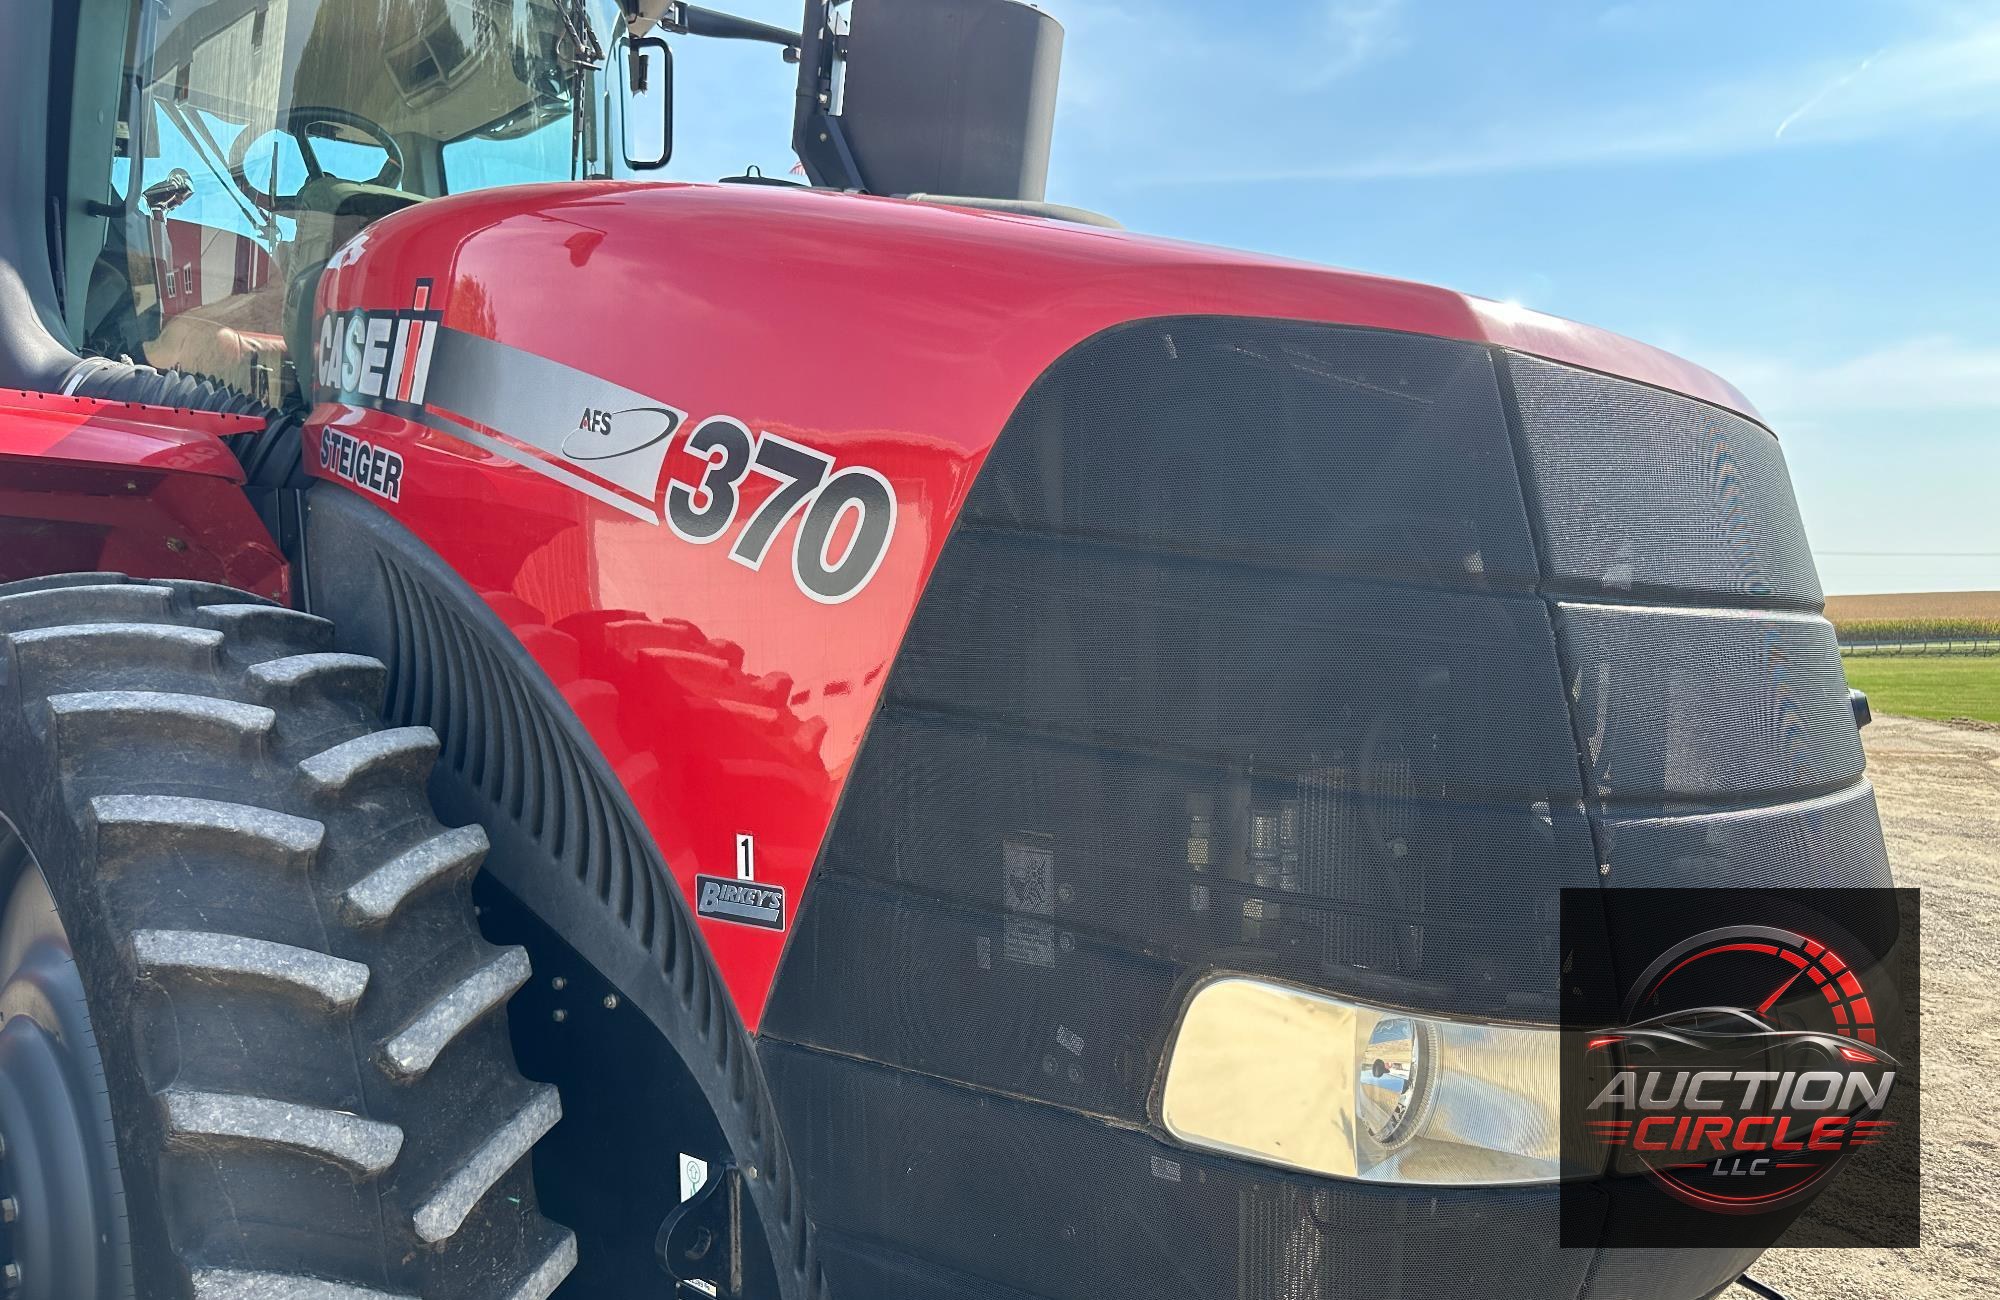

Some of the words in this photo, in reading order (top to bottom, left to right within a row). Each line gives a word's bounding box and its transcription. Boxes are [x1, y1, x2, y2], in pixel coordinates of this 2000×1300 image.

[319, 315, 392, 397] CASE
[579, 407, 612, 436] AFS
[320, 425, 404, 503] STEIGER
[664, 415, 897, 605] 370
[741, 838, 750, 877] 1
[699, 881, 782, 912] BIRKEY'S
